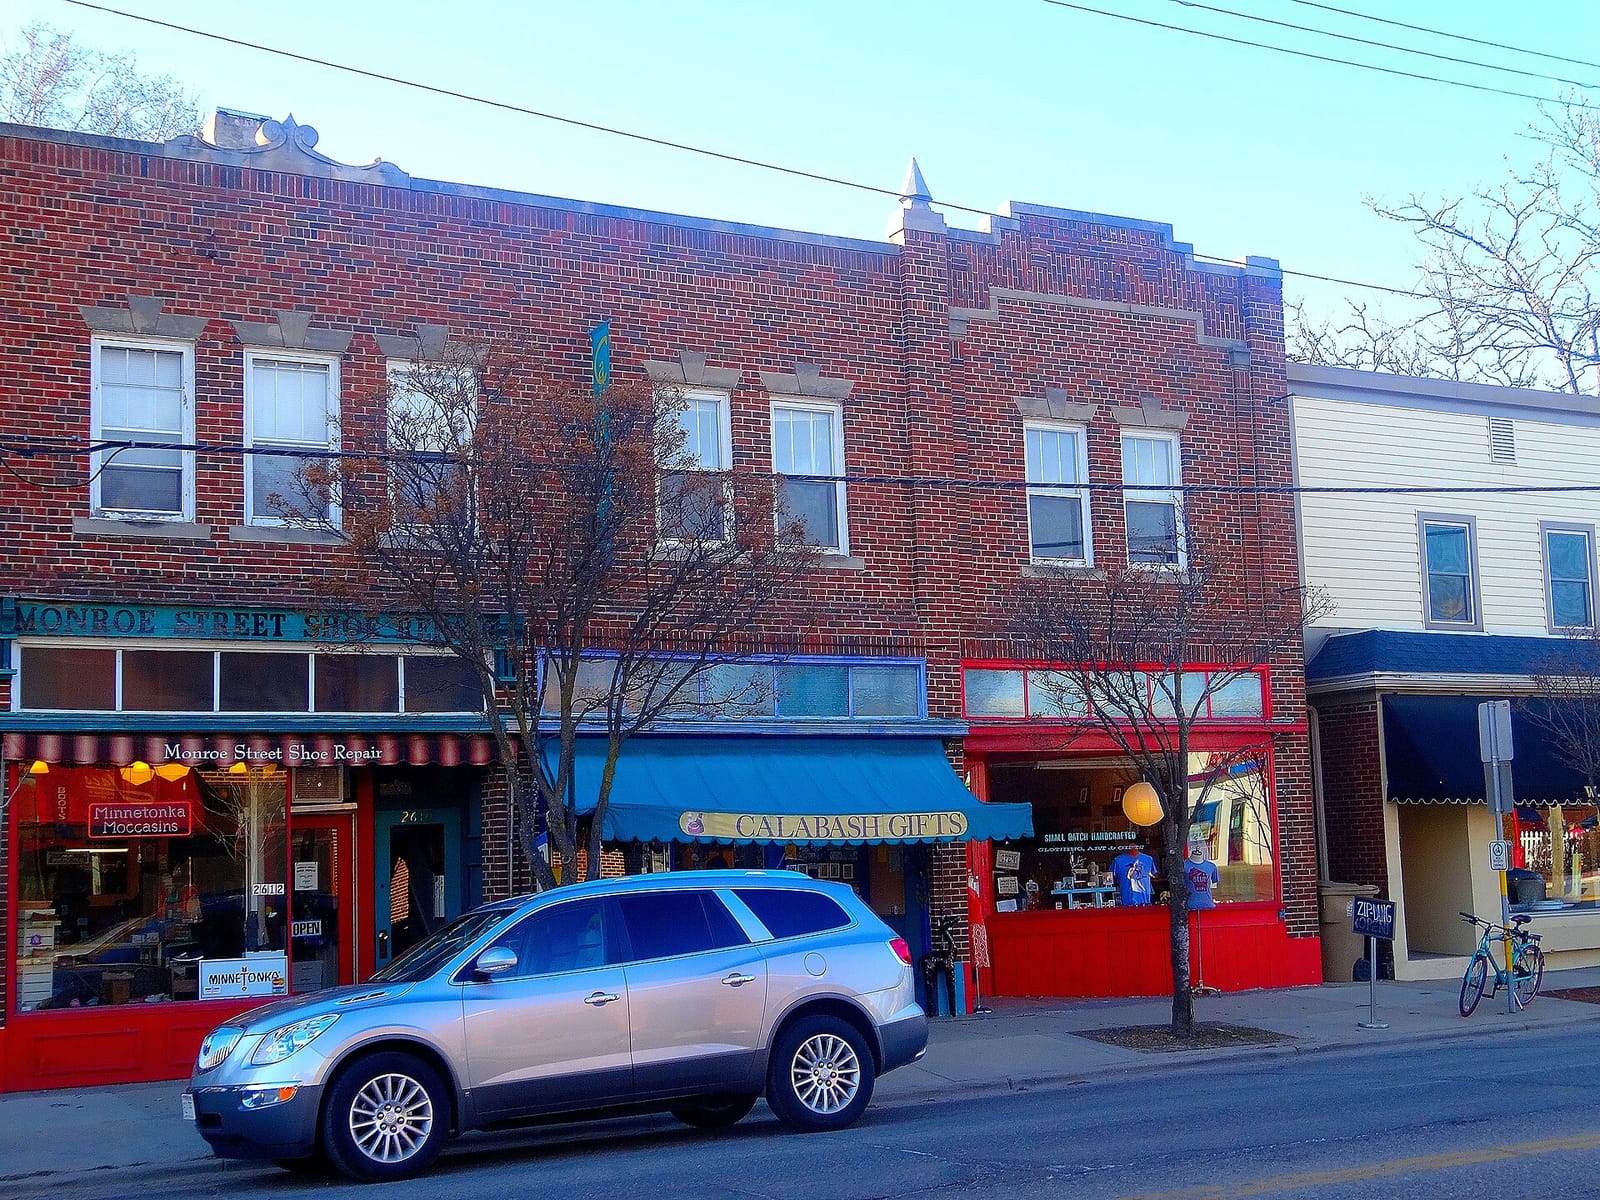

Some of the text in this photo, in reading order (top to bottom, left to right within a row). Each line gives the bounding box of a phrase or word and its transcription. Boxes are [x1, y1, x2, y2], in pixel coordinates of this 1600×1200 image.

[14, 606, 156, 634] MONROE
[173, 611, 287, 637] STREET
[163, 743, 383, 763] Monroe Street Shoe Repair
[57, 786, 67, 820] BOOTS
[93, 806, 186, 820] Minnetonka
[102, 821, 179, 834] Moccasins
[735, 812, 963, 838] CALABASH GIFTS
[1044, 831, 1137, 842] SMALL BATCH HANDCRAFTED
[253, 884, 284, 895] 2612
[292, 921, 320, 936] OPEN
[208, 969, 280, 986] MINNETONKA
